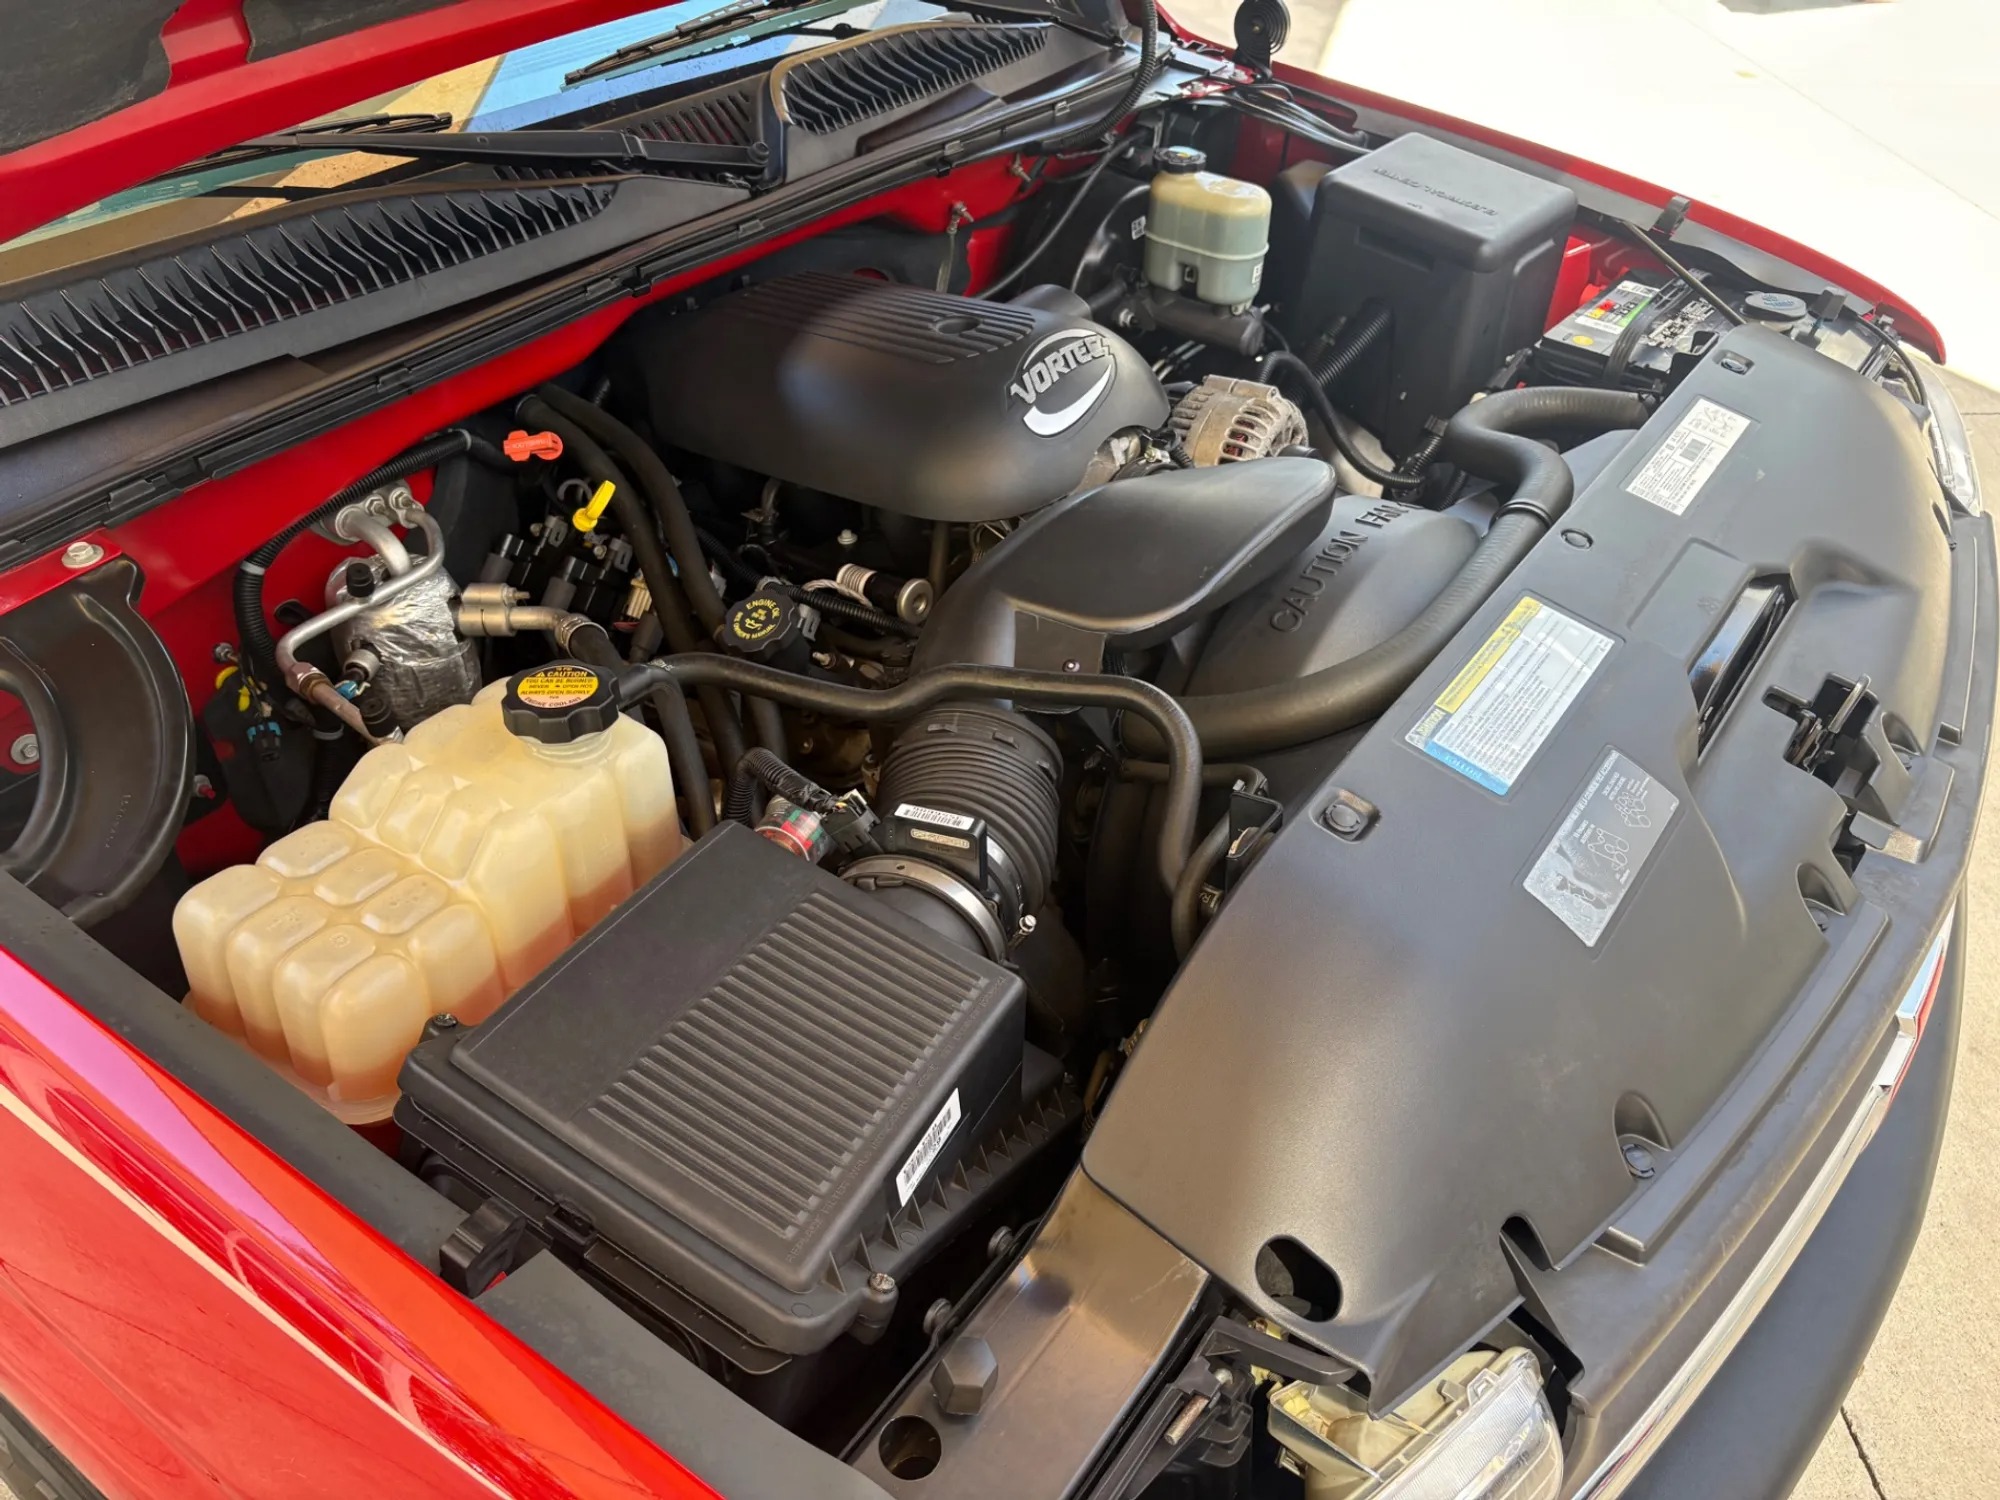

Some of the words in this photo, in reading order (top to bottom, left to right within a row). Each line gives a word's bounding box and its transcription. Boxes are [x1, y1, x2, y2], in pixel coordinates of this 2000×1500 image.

[1010, 336, 1111, 404] VORTEC
[746, 598, 777, 610] ENGINE
[1270, 530, 1369, 633] CAUTION
